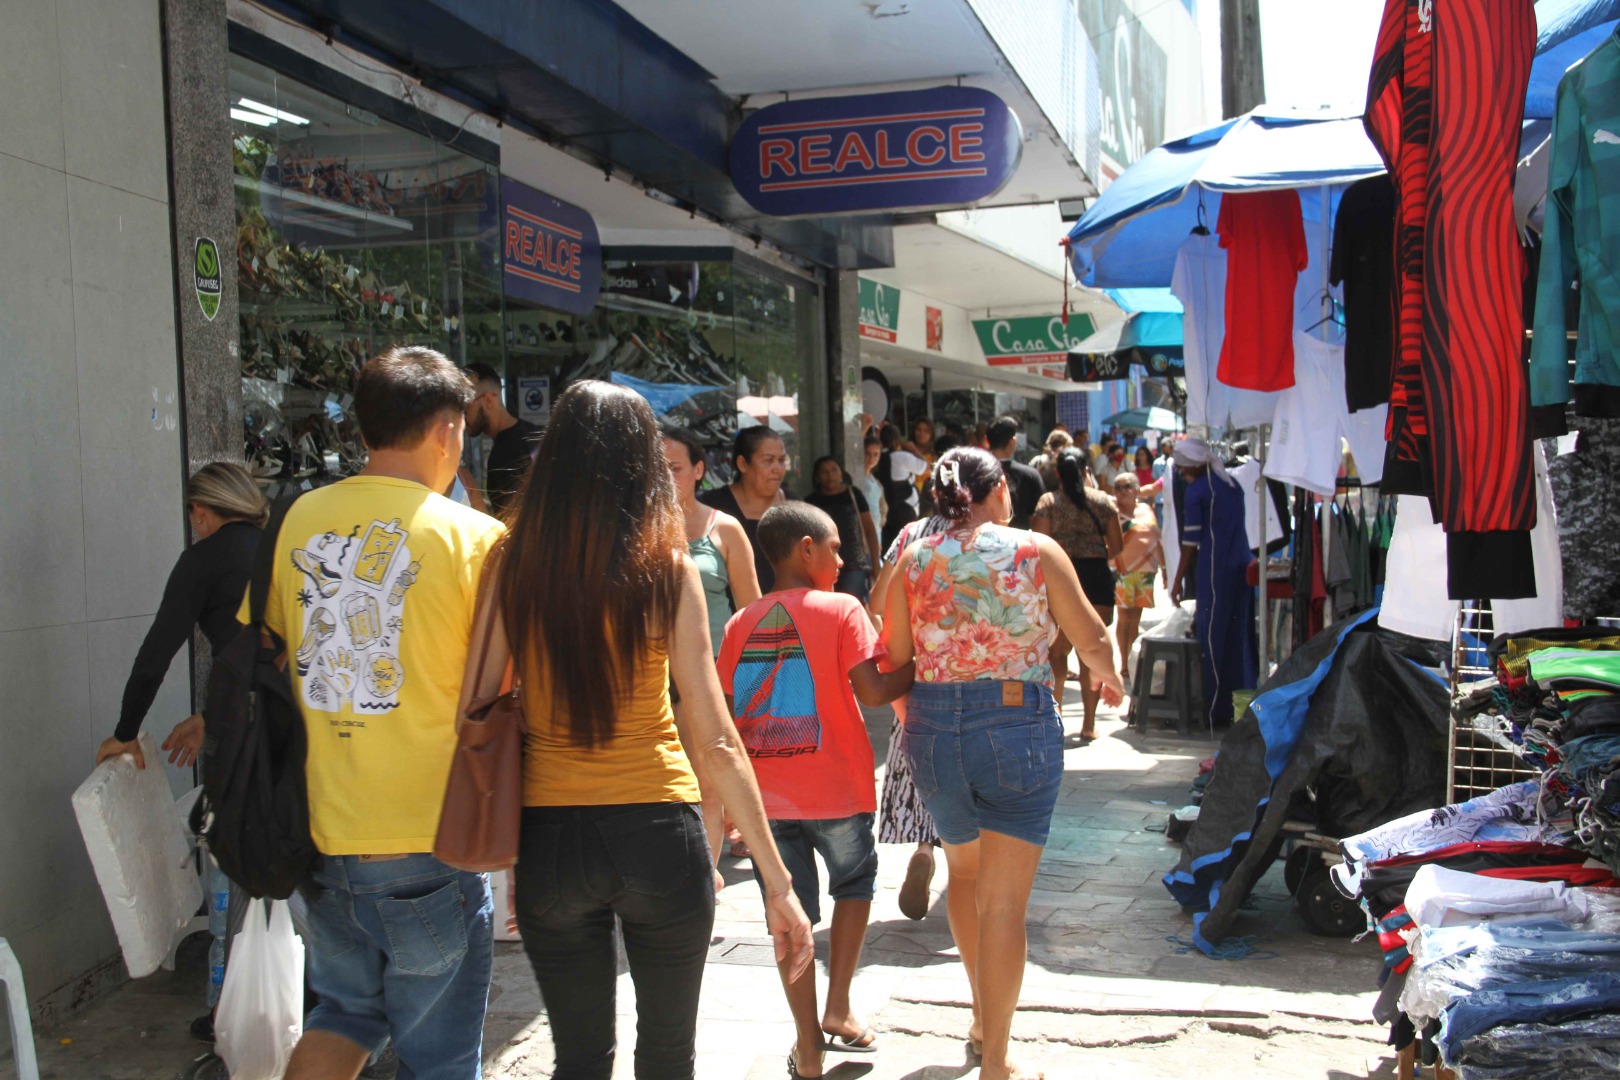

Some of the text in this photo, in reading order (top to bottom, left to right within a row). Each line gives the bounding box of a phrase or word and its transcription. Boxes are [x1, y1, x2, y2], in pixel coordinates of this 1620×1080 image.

[759, 122, 986, 179] REALCE
[506, 219, 582, 279] REALCE
[992, 320, 1048, 353] Casa
